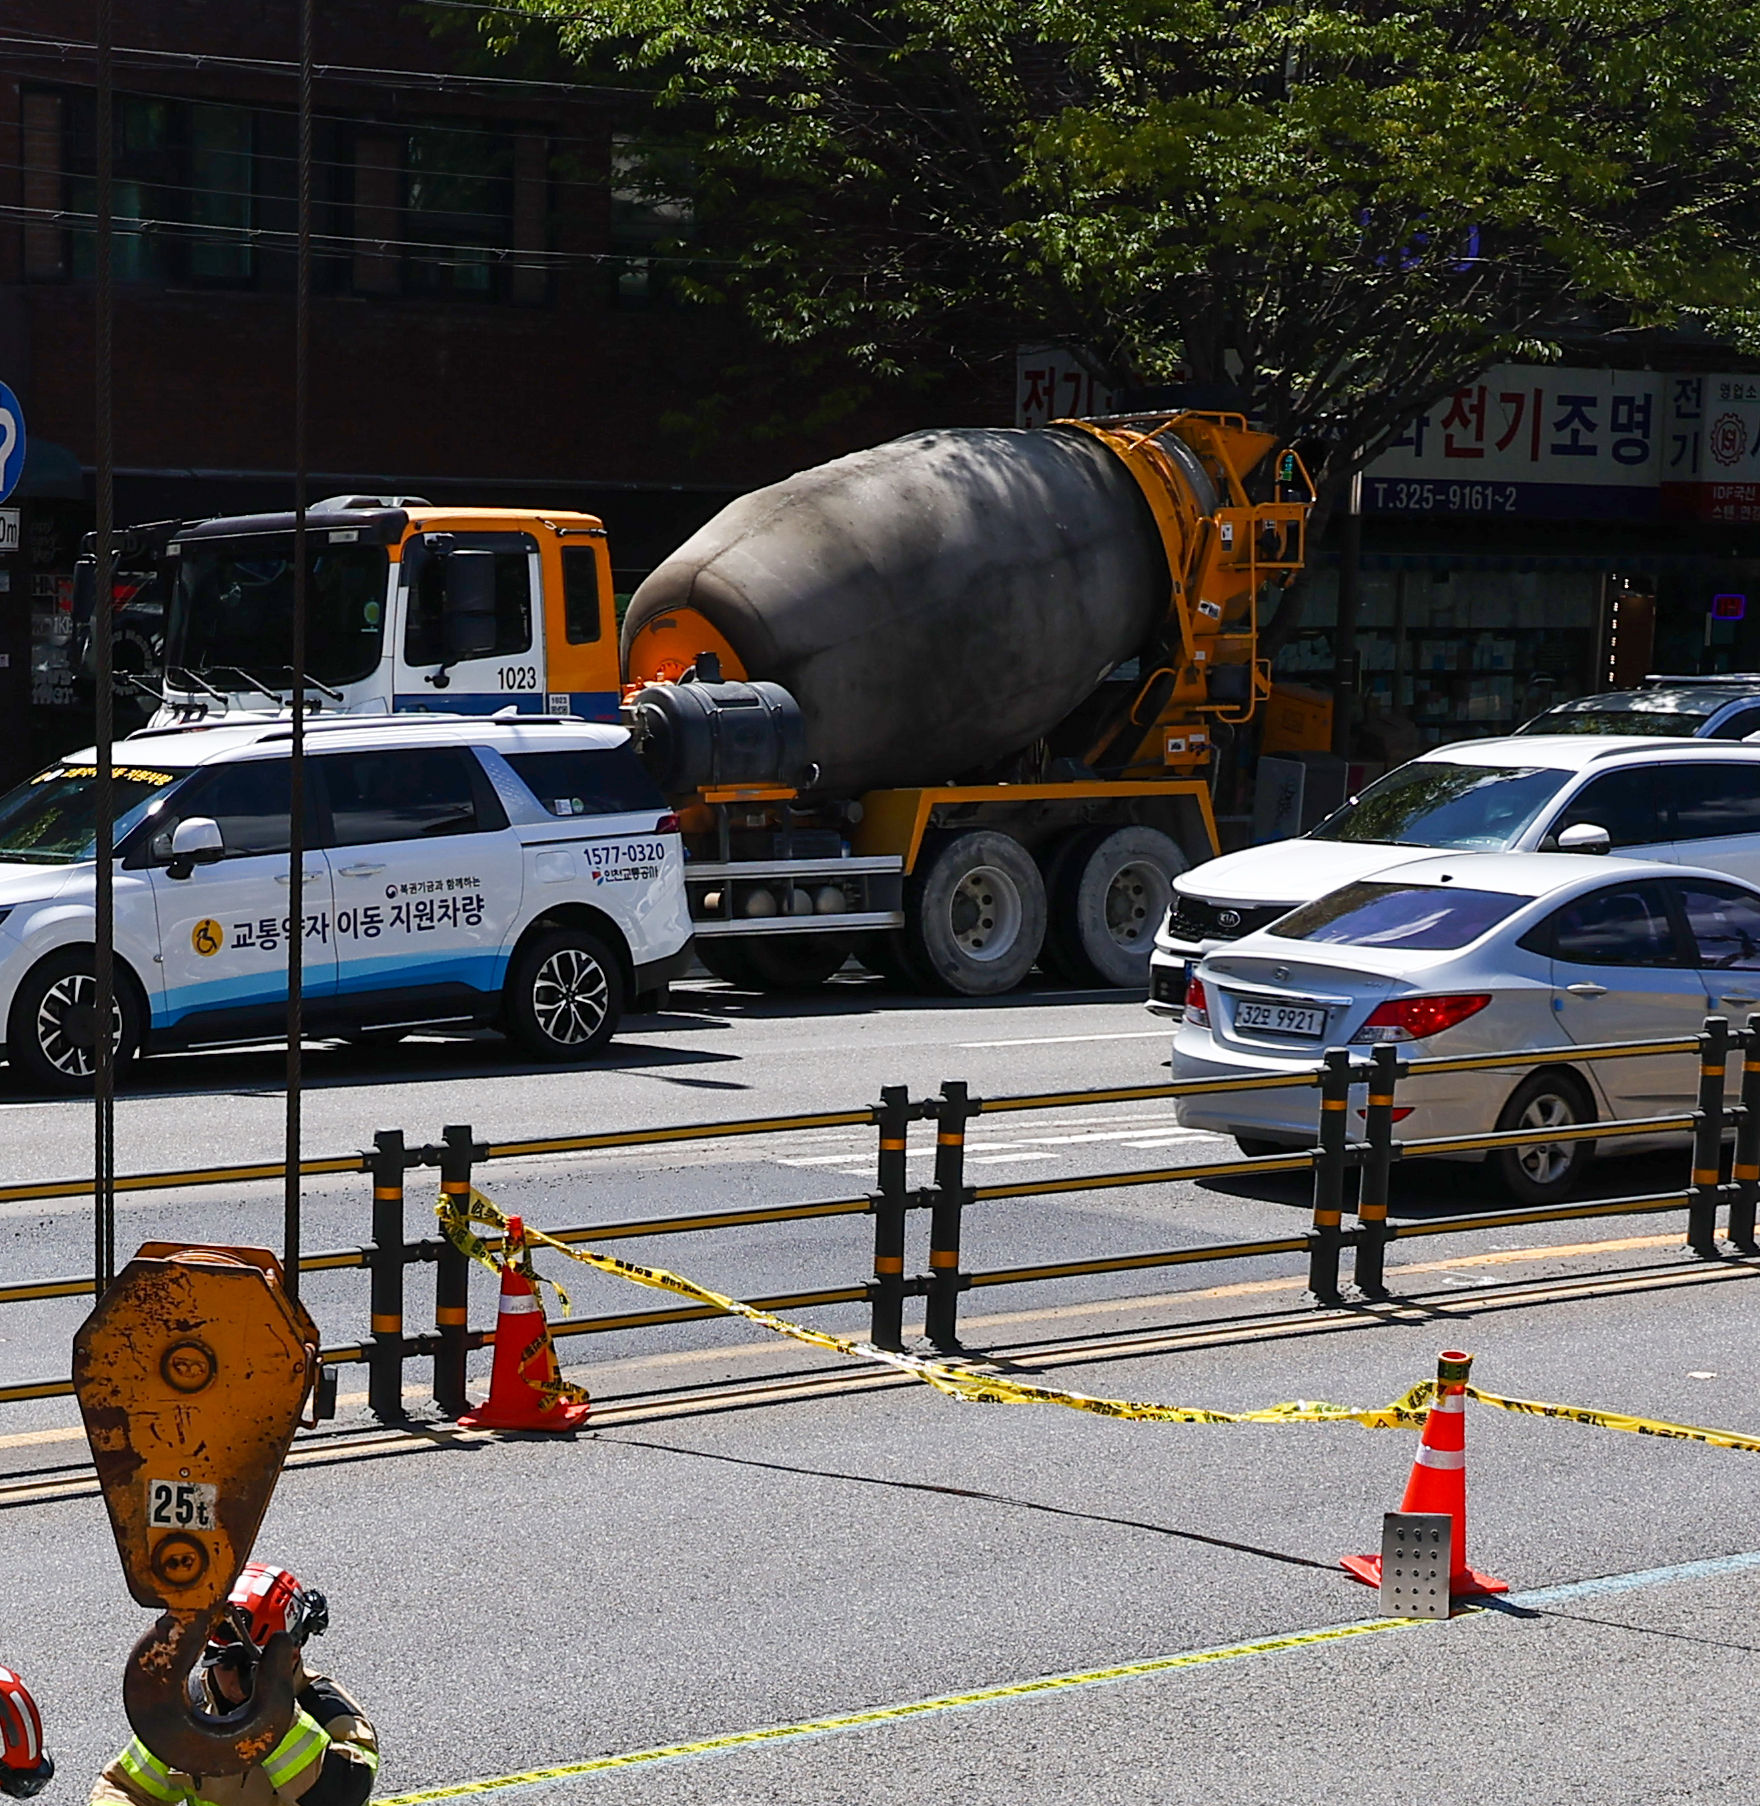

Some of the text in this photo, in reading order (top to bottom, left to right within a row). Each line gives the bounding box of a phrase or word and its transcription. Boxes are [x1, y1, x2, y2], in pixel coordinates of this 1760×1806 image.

[1720, 383, 1757, 400] 영업소
[1374, 484, 1516, 511] T.325-9161~2
[497, 666, 537, 690] 1023
[583, 841, 665, 867] 1577-0320
[604, 866, 659, 883] 인천교통공사
[336, 904, 385, 941] 이동
[389, 893, 486, 932] 지원차량
[1220, 913, 1236, 925] KIA
[1277, 1009, 1315, 1031] 9921
[154, 1484, 209, 1526] 25t
